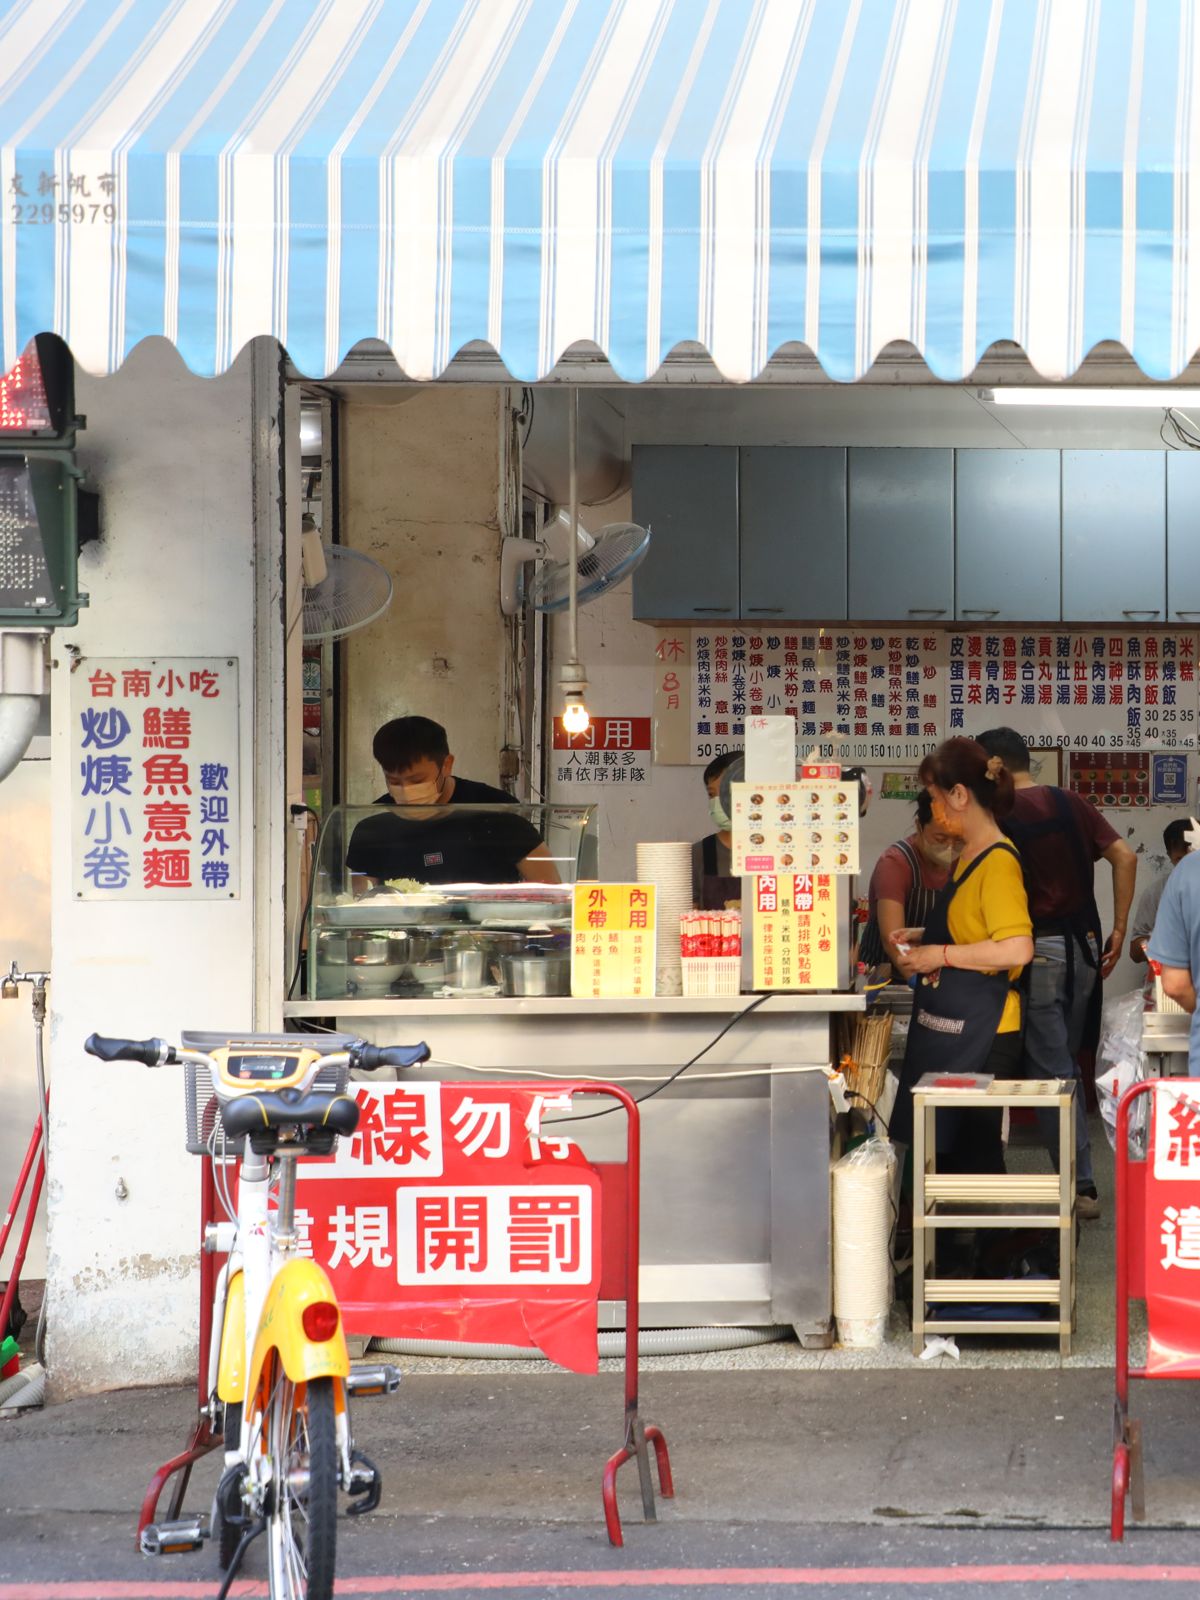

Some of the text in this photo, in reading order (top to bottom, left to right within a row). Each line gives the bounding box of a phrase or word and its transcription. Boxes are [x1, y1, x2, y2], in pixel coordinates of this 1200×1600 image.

[11, 204, 118, 224] 2295979
[967, 636, 982, 705] 燙青菜
[985, 636, 999, 705] 乾骨肉
[1021, 636, 1035, 705] 綜合湯
[1038, 636, 1052, 705] 貢丸湯
[1074, 636, 1088, 705] 小肚湯
[1092, 636, 1106, 705] 骨肉湯
[1109, 636, 1123, 705] 四神湯
[1144, 636, 1158, 705] 魚酥飯
[1162, 636, 1176, 705] 肉燥飯
[1180, 636, 1194, 682] 米糕
[88, 668, 220, 698] 台南小吃
[906, 636, 920, 736] 乾炒鱔魚意麵
[923, 636, 937, 736] 乾炒鱔魚
[950, 636, 964, 728] 皮蛋豆腐
[1127, 636, 1141, 728] 魚酥肉飯
[1127, 728, 1140, 739] 35
[1145, 710, 1158, 721] 30
[1145, 728, 1158, 738] 40
[1162, 710, 1176, 721] 25
[1180, 710, 1193, 721] 35
[567, 751, 636, 766] 人潮較多
[697, 744, 712, 757] 50
[820, 744, 833, 757] 150
[854, 744, 867, 757] 100
[871, 744, 885, 757] 150
[888, 745, 901, 758] 110
[905, 744, 918, 757] 110
[1039, 736, 1052, 747] 30
[1057, 736, 1070, 747] 50
[1074, 736, 1088, 747] 40
[1092, 736, 1105, 747] 40
[1110, 736, 1123, 747] 35
[557, 767, 645, 782] 請依序排隊
[142, 707, 192, 889] 鱔魚意麵
[200, 763, 229, 889] 歡迎外帶
[588, 889, 608, 929] 外帶
[629, 889, 648, 929] 內用
[758, 875, 777, 911] 內用
[795, 875, 813, 911] 外帶
[797, 914, 811, 985] 請排隊點餐
[300, 1088, 574, 1166] 線勿
